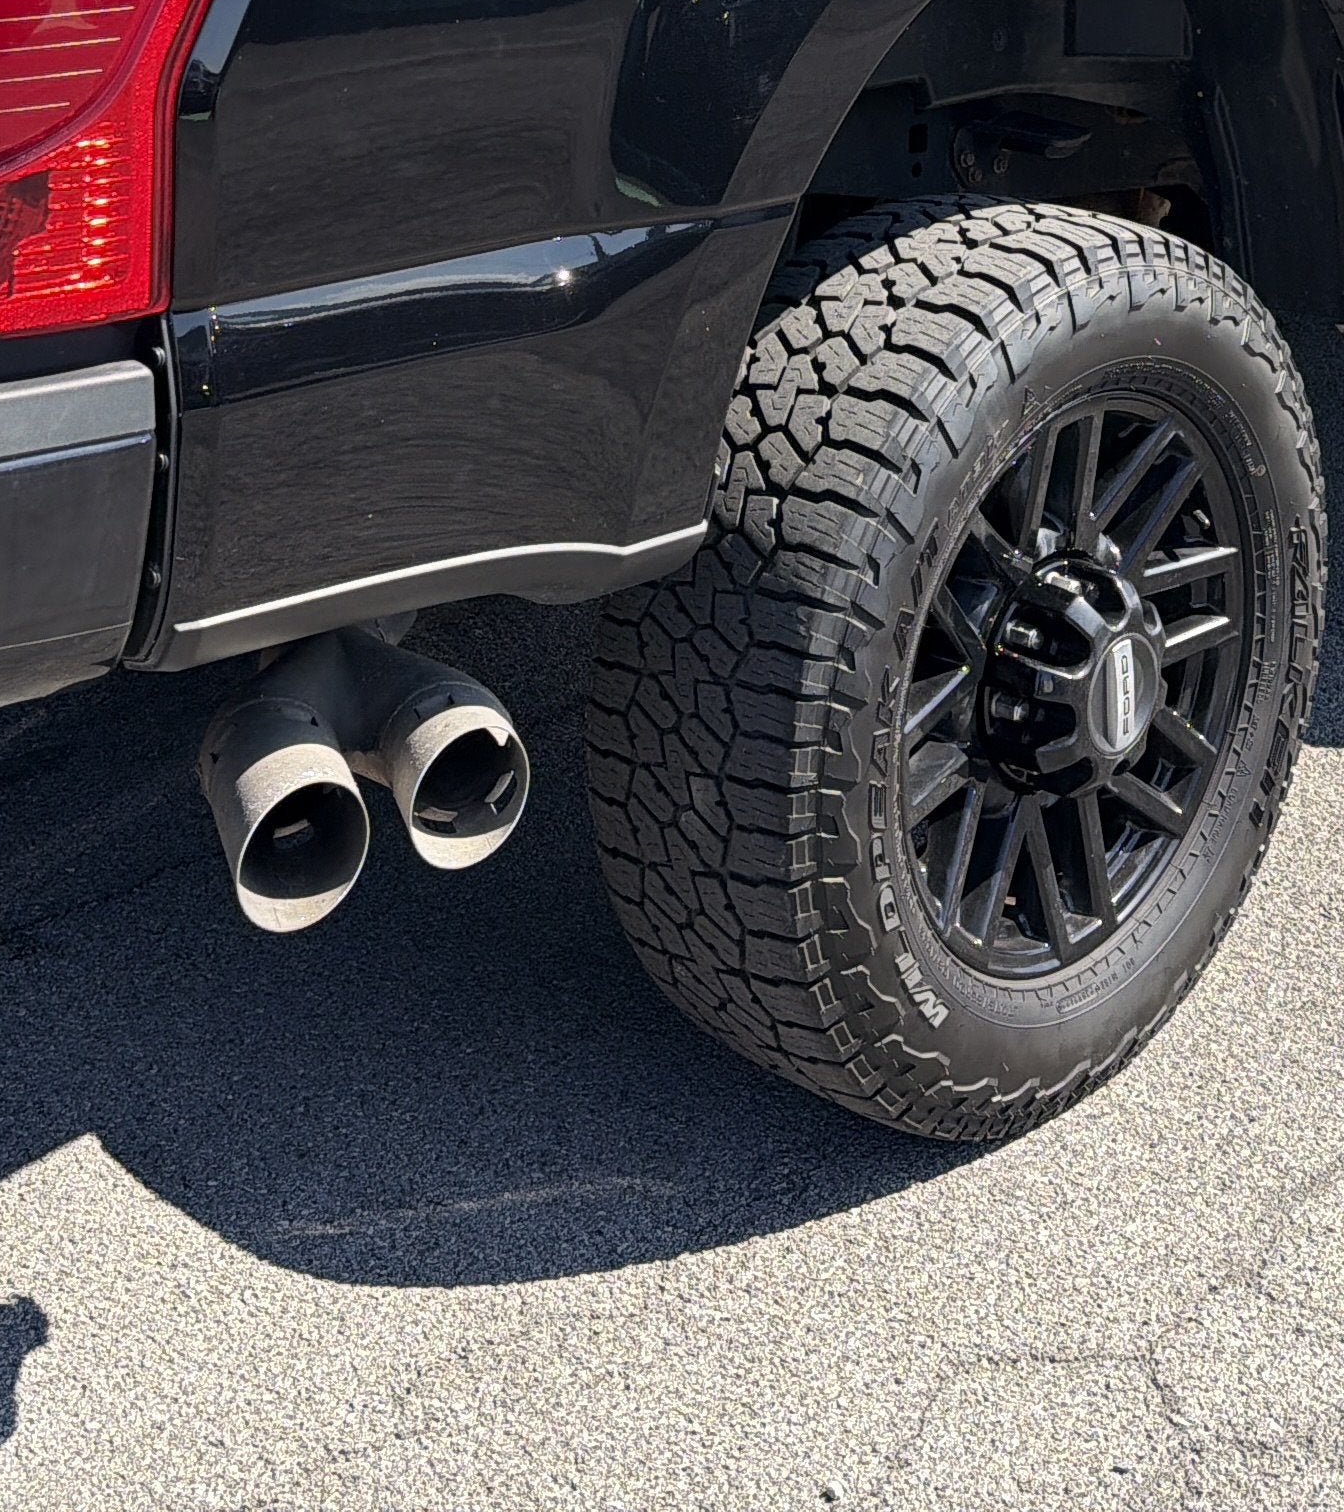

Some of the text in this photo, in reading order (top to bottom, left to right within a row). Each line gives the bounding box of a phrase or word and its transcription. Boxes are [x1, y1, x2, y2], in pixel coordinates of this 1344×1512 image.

[1121, 654, 1130, 736] FORD
[1248, 514, 1308, 828] FALKEN
[867, 664, 950, 1030] WILDPEAK
